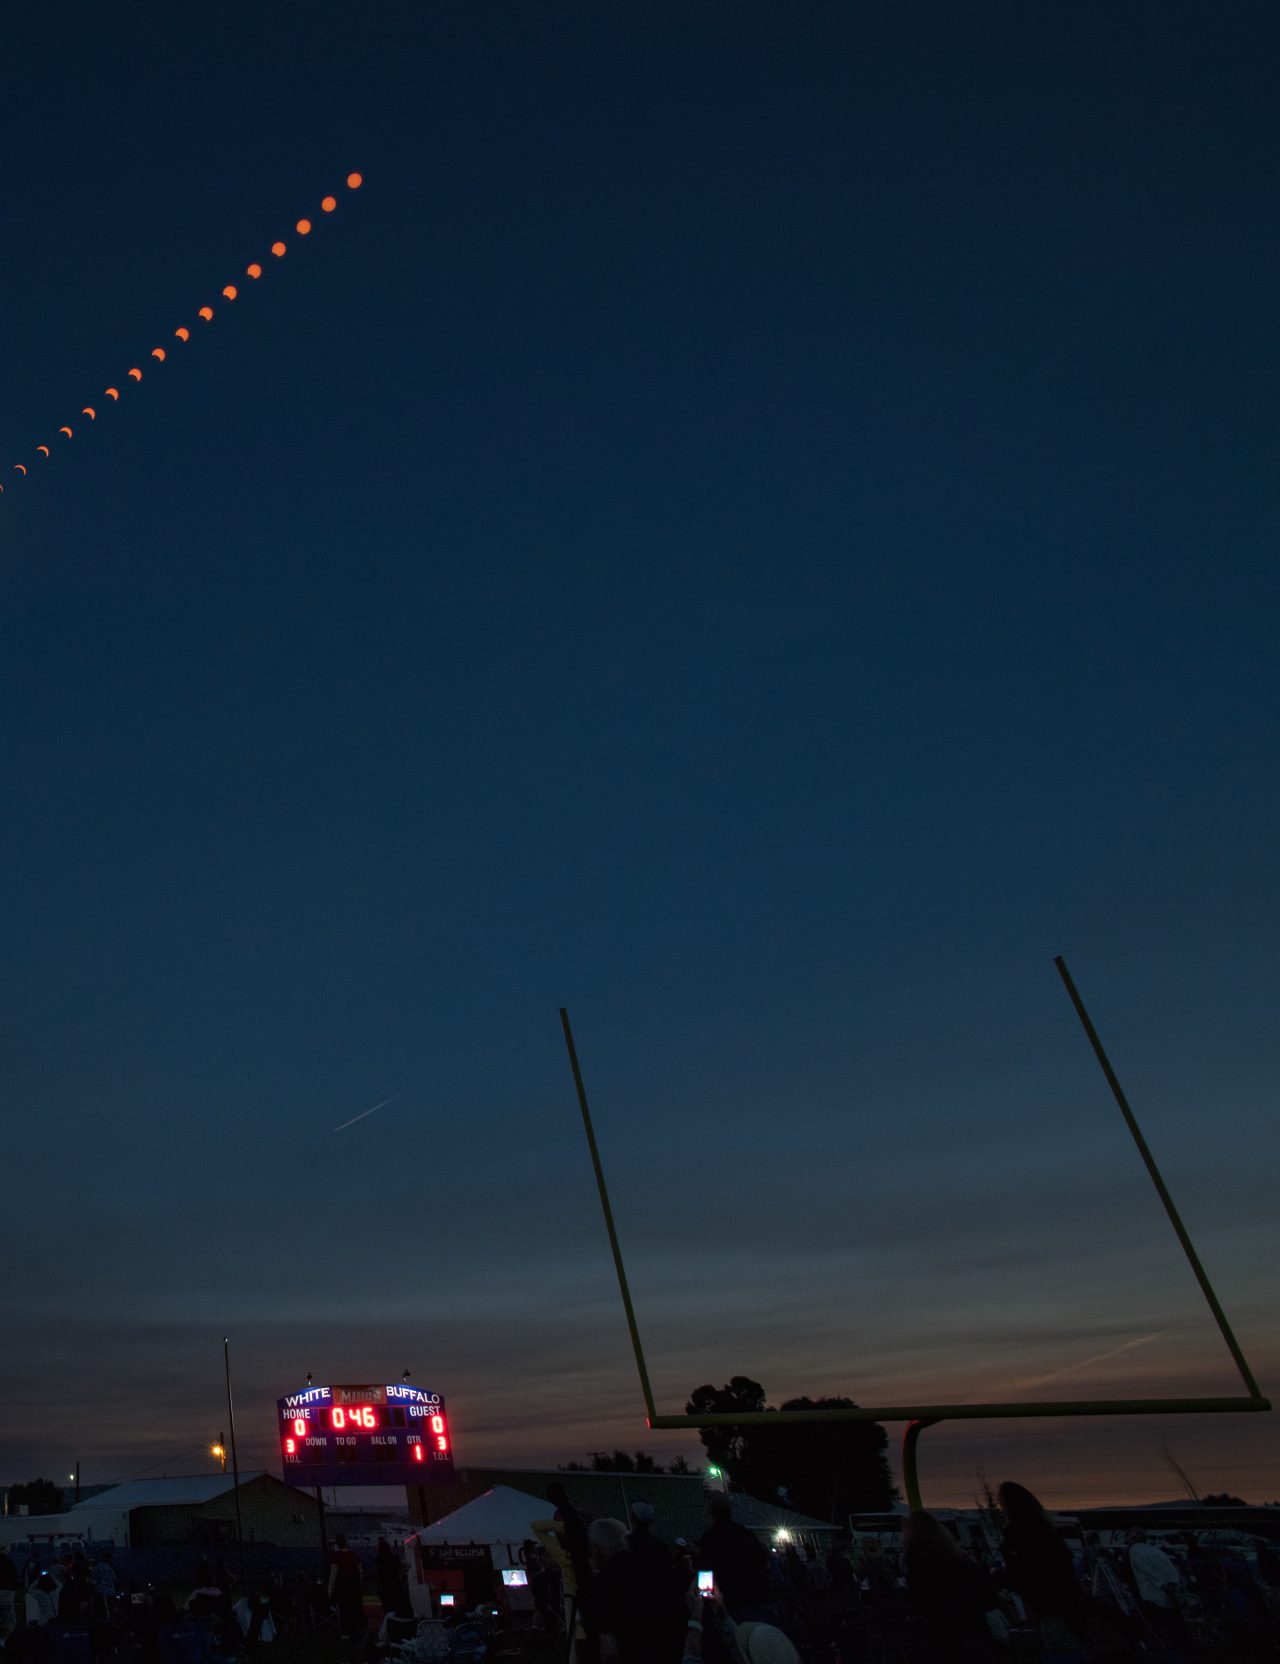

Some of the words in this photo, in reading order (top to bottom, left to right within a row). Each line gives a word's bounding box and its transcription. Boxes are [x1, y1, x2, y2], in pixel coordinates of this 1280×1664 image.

[285, 1387, 331, 1407] WHITE
[386, 1386, 440, 1404] BUFFALO
[283, 1408, 311, 1420] HOME
[409, 1405, 440, 1417] GUEST
[294, 1418, 306, 1436] 0
[431, 1416, 443, 1434] 0
[286, 1439, 295, 1453] 3
[305, 1437, 327, 1446] DOWN
[336, 1437, 345, 1446] TO
[346, 1437, 357, 1446] GO
[371, 1436, 387, 1445] BALL
[387, 1436, 397, 1445] ON
[406, 1435, 422, 1444] QTR
[438, 1436, 447, 1450] 3
[415, 1444, 422, 1461] 1
